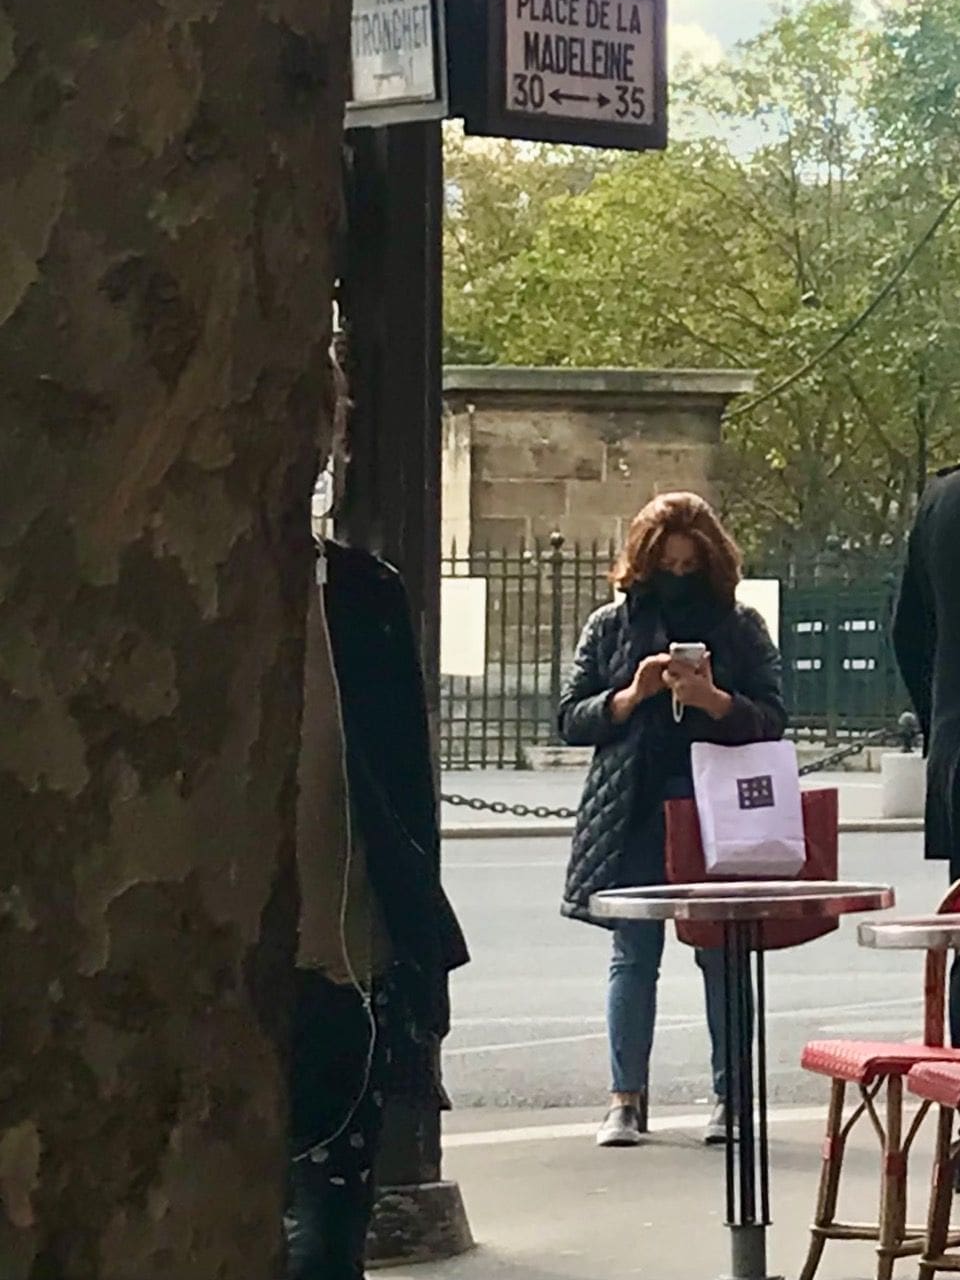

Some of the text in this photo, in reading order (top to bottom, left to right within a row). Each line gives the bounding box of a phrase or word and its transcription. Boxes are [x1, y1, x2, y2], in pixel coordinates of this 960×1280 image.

[351, 4, 429, 58] TRONCHET
[616, 3, 642, 34] LA
[523, 31, 635, 83] MADELEINE
[513, 73, 646, 119] 30 35
